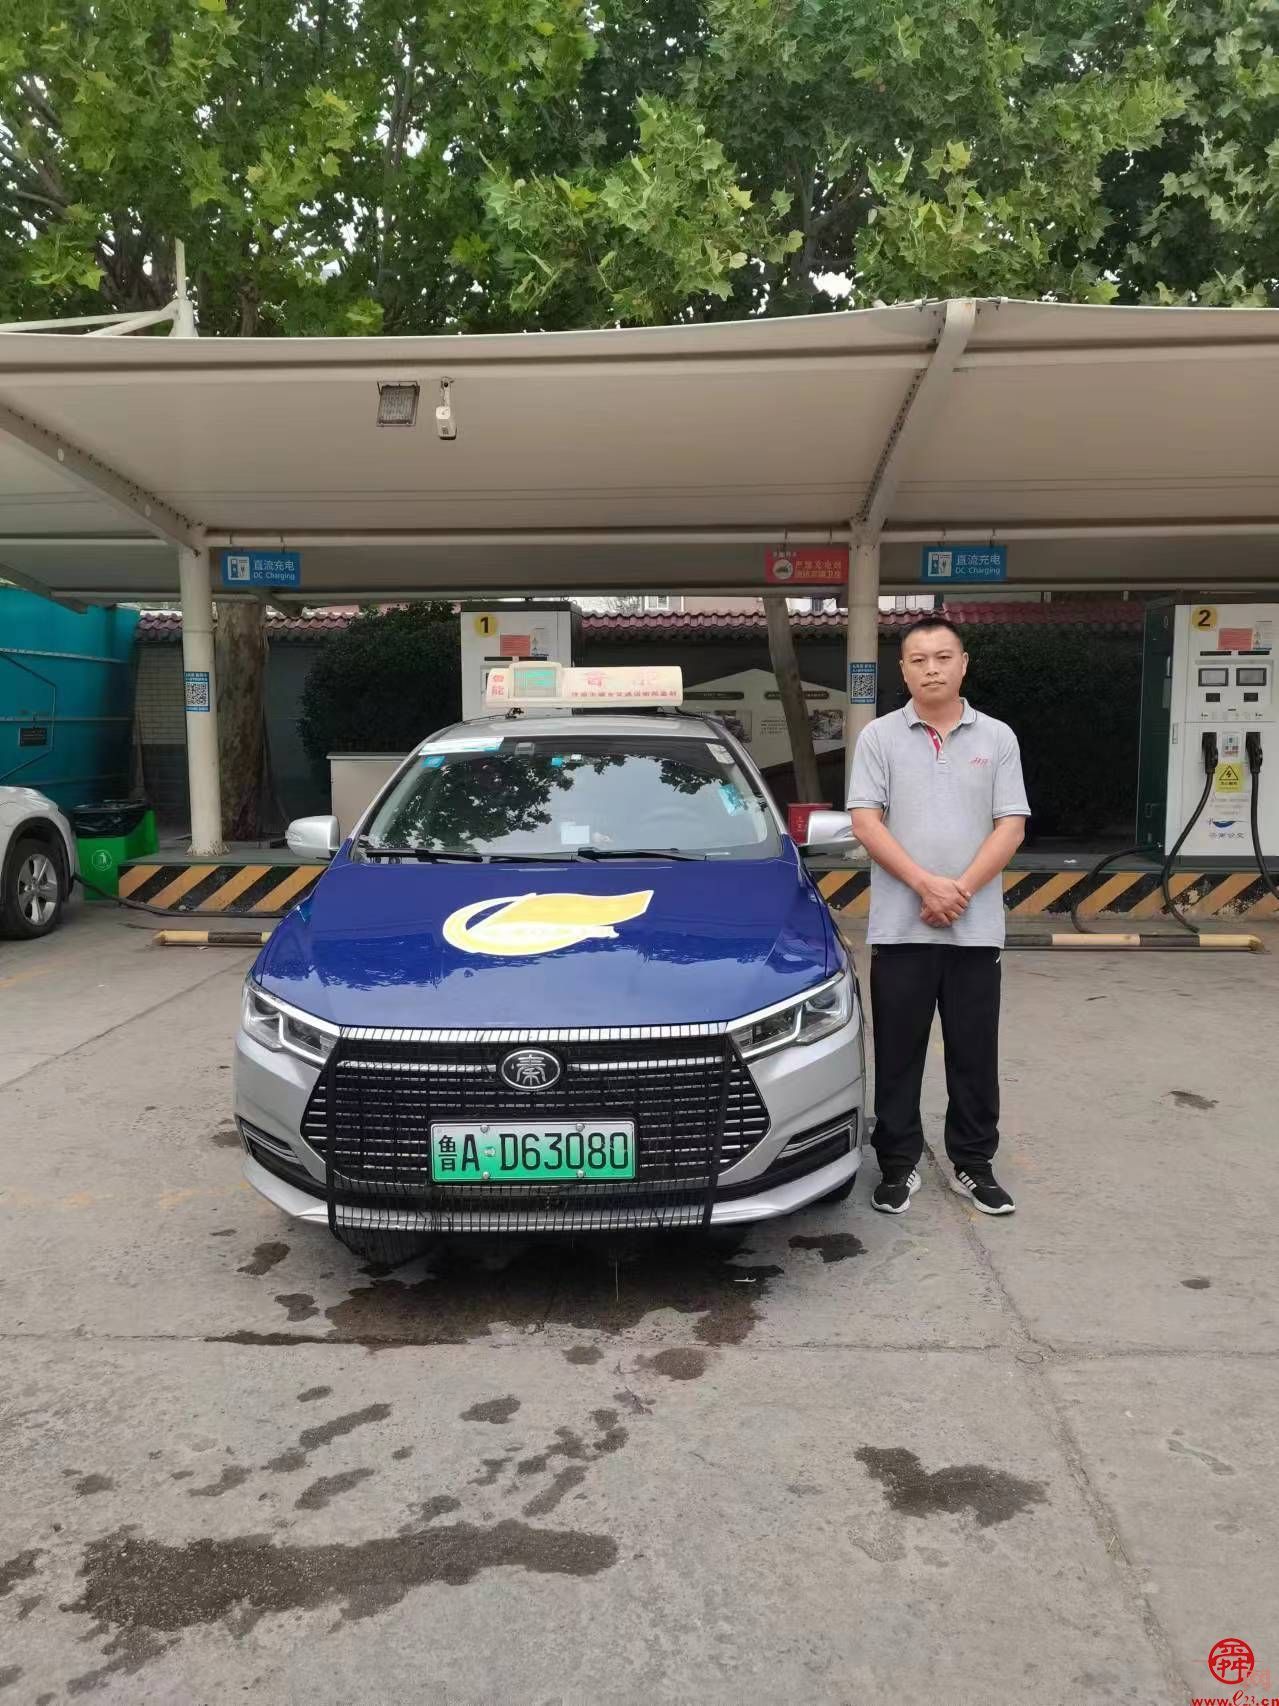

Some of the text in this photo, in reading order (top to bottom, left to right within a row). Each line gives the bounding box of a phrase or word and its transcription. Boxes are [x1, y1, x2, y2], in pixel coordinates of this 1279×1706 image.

[254, 560, 295, 571] 直流充电
[954, 552, 1000, 566] 直流充电
[265, 571, 295, 580] Charging
[955, 566, 1000, 576] DC Charging
[480, 616, 489, 633] 1
[1198, 609, 1211, 627] 2
[499, 1132, 628, 1171] D63080
